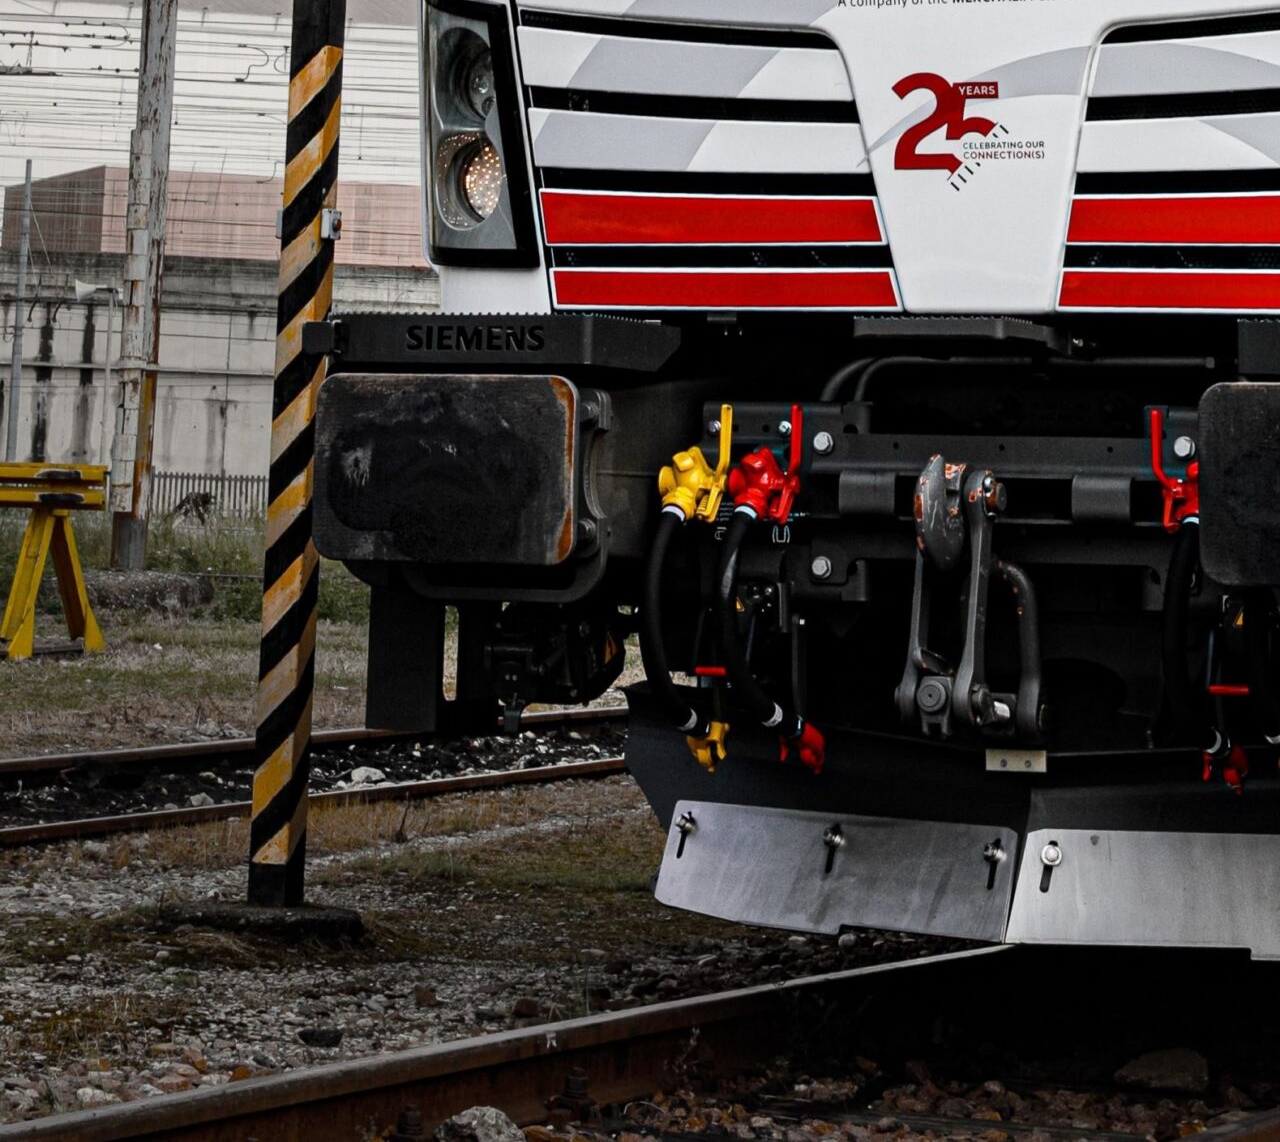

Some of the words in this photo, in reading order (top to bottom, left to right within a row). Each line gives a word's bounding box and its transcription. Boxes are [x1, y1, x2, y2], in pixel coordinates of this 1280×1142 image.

[958, 85, 996, 96] YEARS
[891, 72, 999, 181] 25
[963, 141, 1024, 150] CELEBRATING
[1025, 140, 1045, 149] OUR
[963, 150, 1045, 160] CONNECTION(S)
[406, 324, 546, 352] SIEMENS
